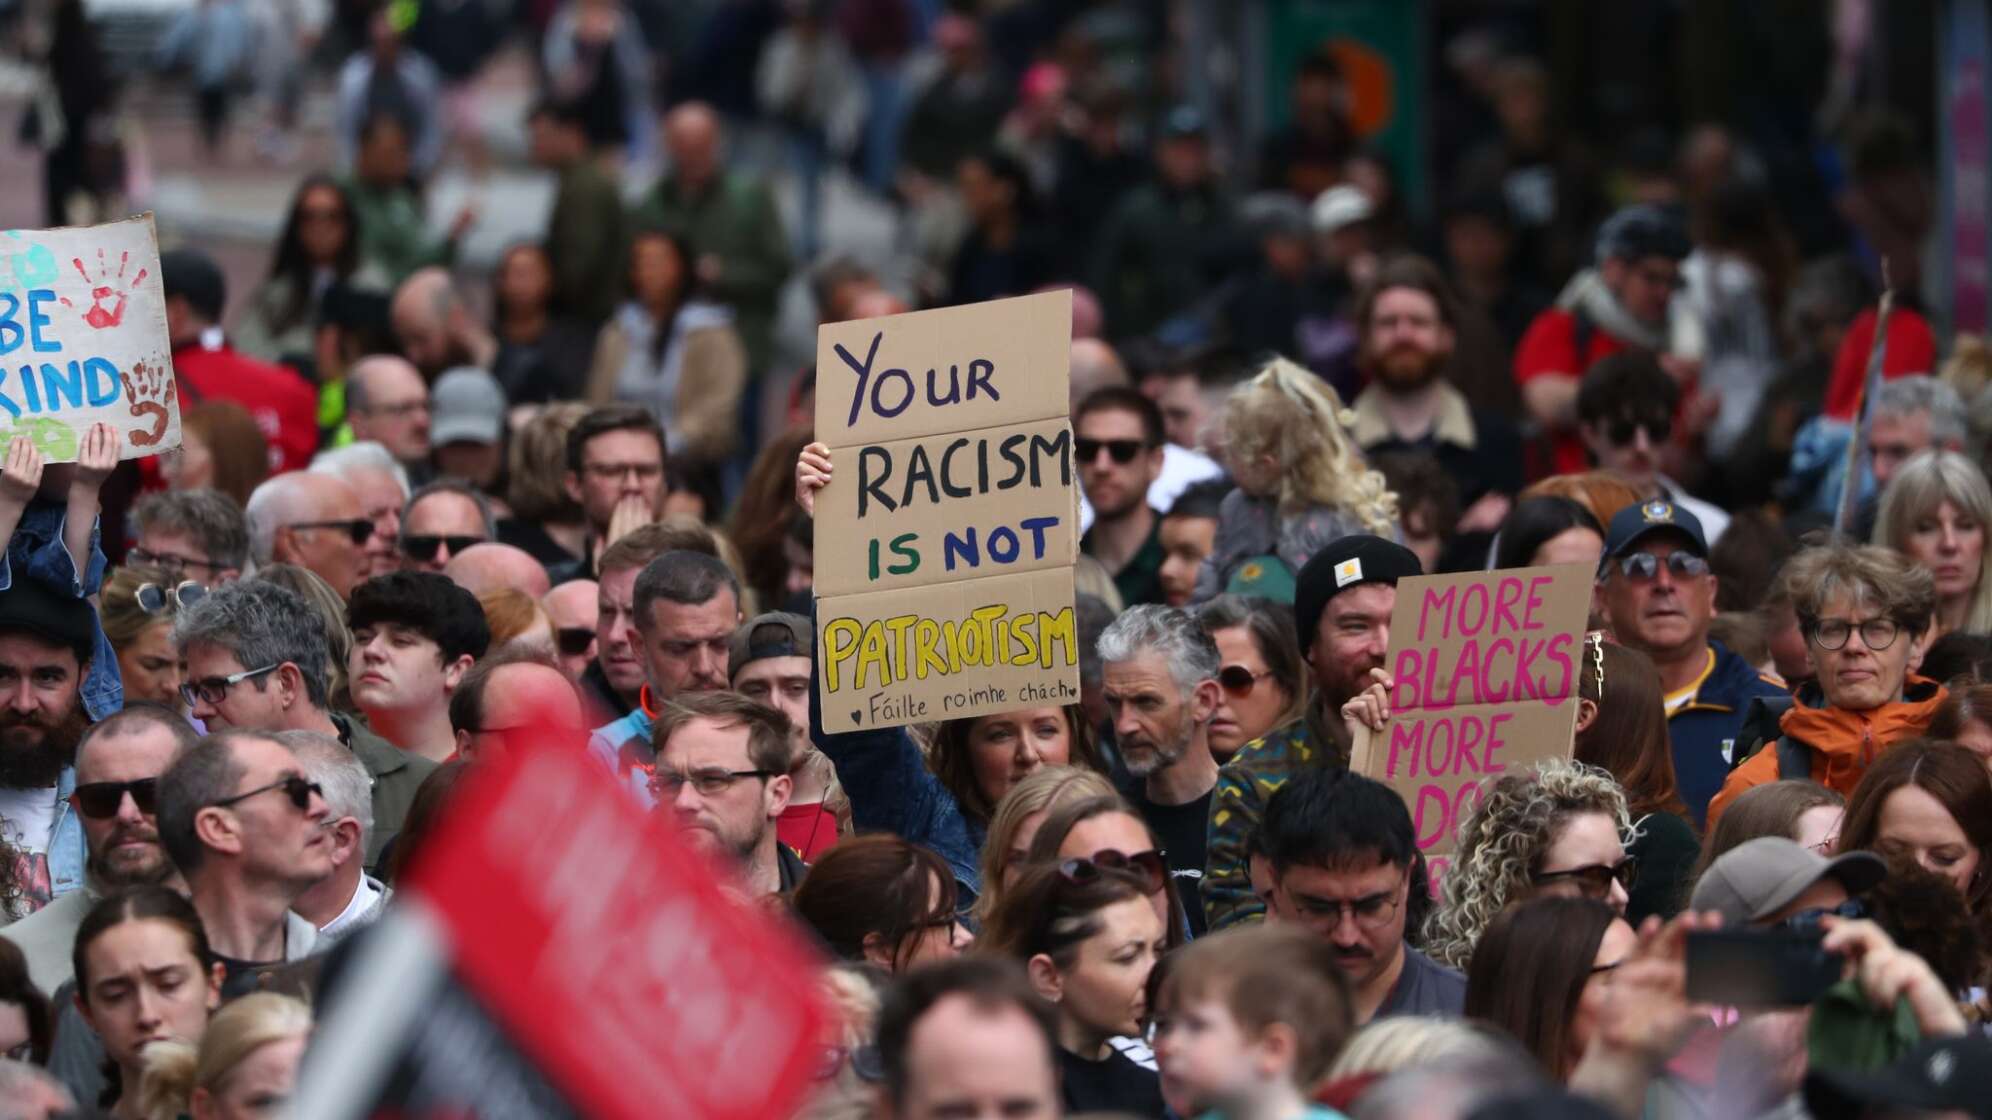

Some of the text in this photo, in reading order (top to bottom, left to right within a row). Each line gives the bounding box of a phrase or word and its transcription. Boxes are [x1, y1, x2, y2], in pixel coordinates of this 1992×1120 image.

[0, 289, 62, 354] BE
[858, 429, 1071, 518] RACISM
[868, 516, 1059, 581] IS NOT
[1417, 576, 1553, 641] MORE
[823, 603, 1077, 693] PATRIOTISM
[1391, 632, 1574, 714] BLACKS
[869, 679, 1069, 724] Fáilte roimhe chách
[1386, 713, 1514, 779] MORE
